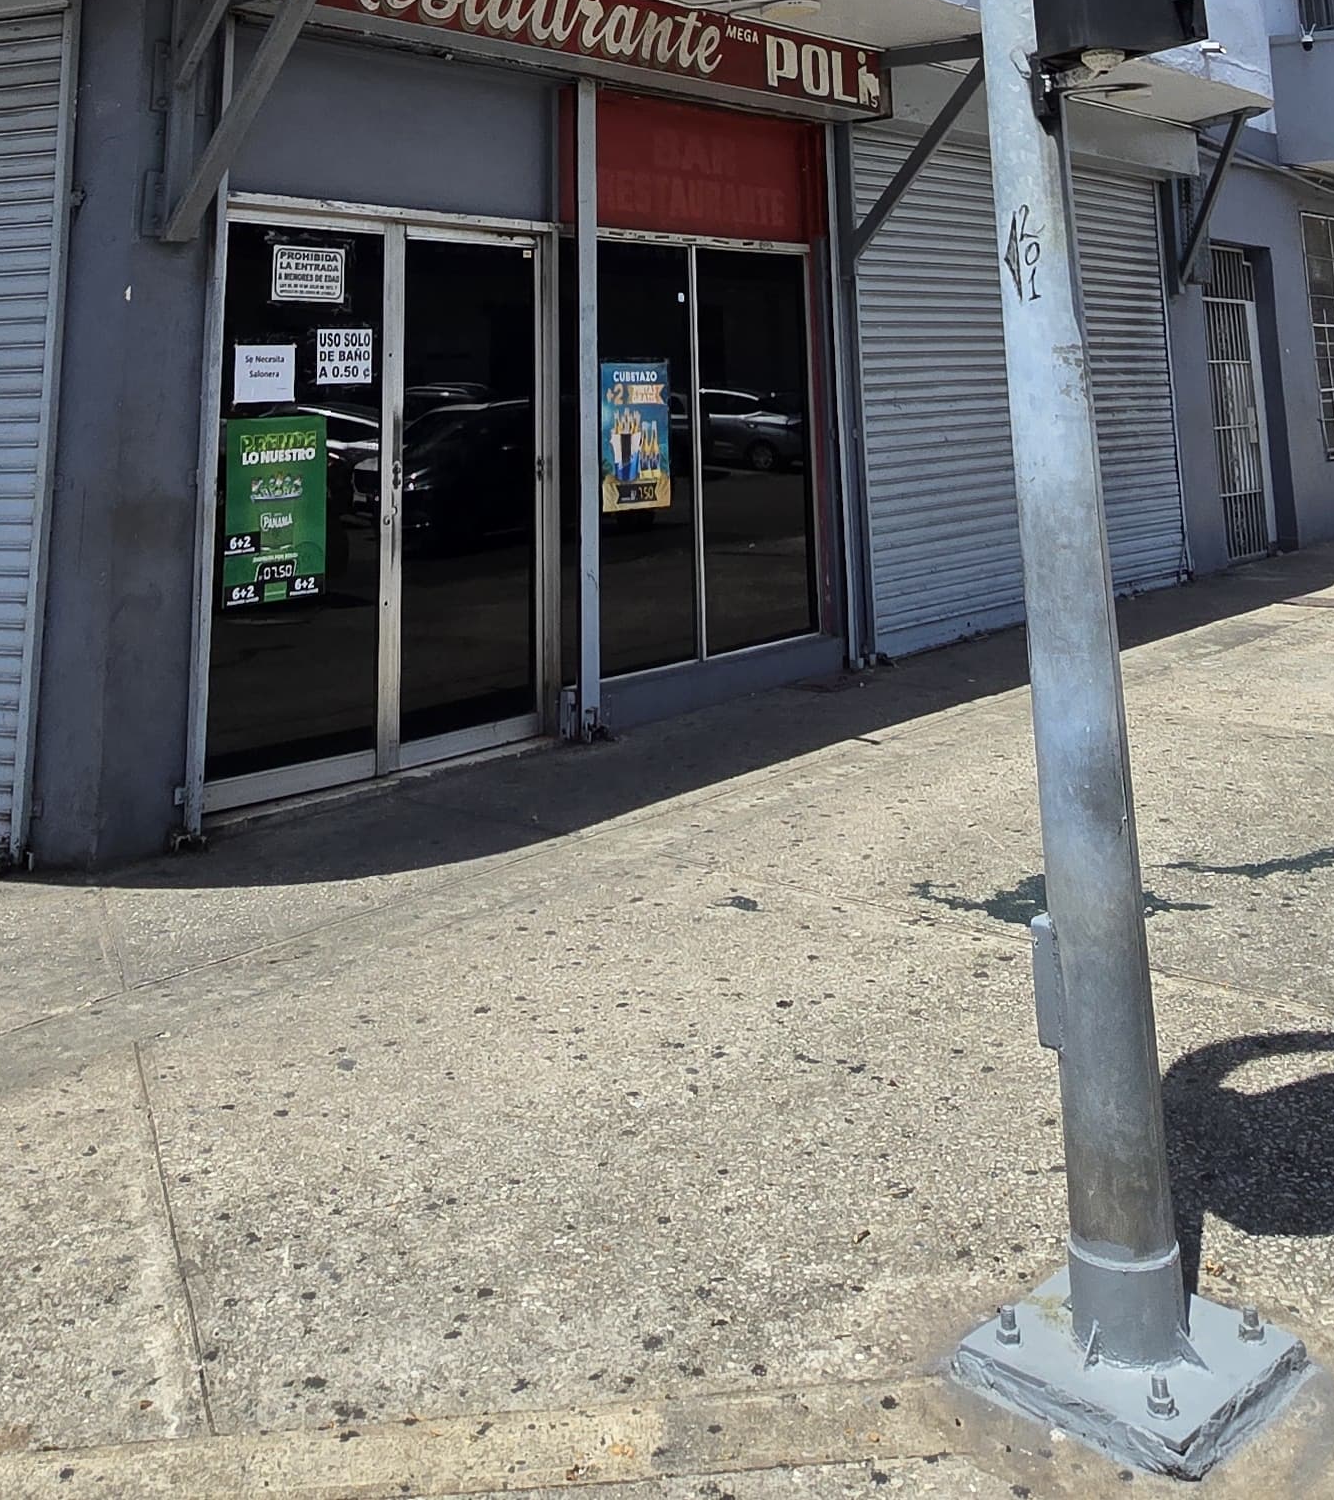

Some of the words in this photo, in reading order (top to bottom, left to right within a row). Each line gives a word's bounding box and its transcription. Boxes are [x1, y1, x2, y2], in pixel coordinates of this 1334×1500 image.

[725, 24, 760, 45] MEGA
[279, 251, 339, 263] PROHIBIDA
[279, 261, 293, 270] LA
[294, 262, 339, 273] ENTRADA
[319, 332, 341, 348] USO
[343, 332, 371, 348] SOLO
[245, 355, 254, 364] Se
[255, 355, 285, 364] Necesita
[319, 350, 334, 362] DE
[338, 348, 371, 362] BAÑO
[249, 369, 280, 378] Salonera
[319, 366, 328, 378] A
[332, 365, 359, 378] 0.50
[613, 370, 658, 383] CUBETAZO
[242, 451, 260, 466] LO
[260, 447, 316, 464] NUESTRO
[229, 535, 252, 550] 6+2
[294, 576, 316, 590] 6+2
[232, 585, 255, 600] 6+2
